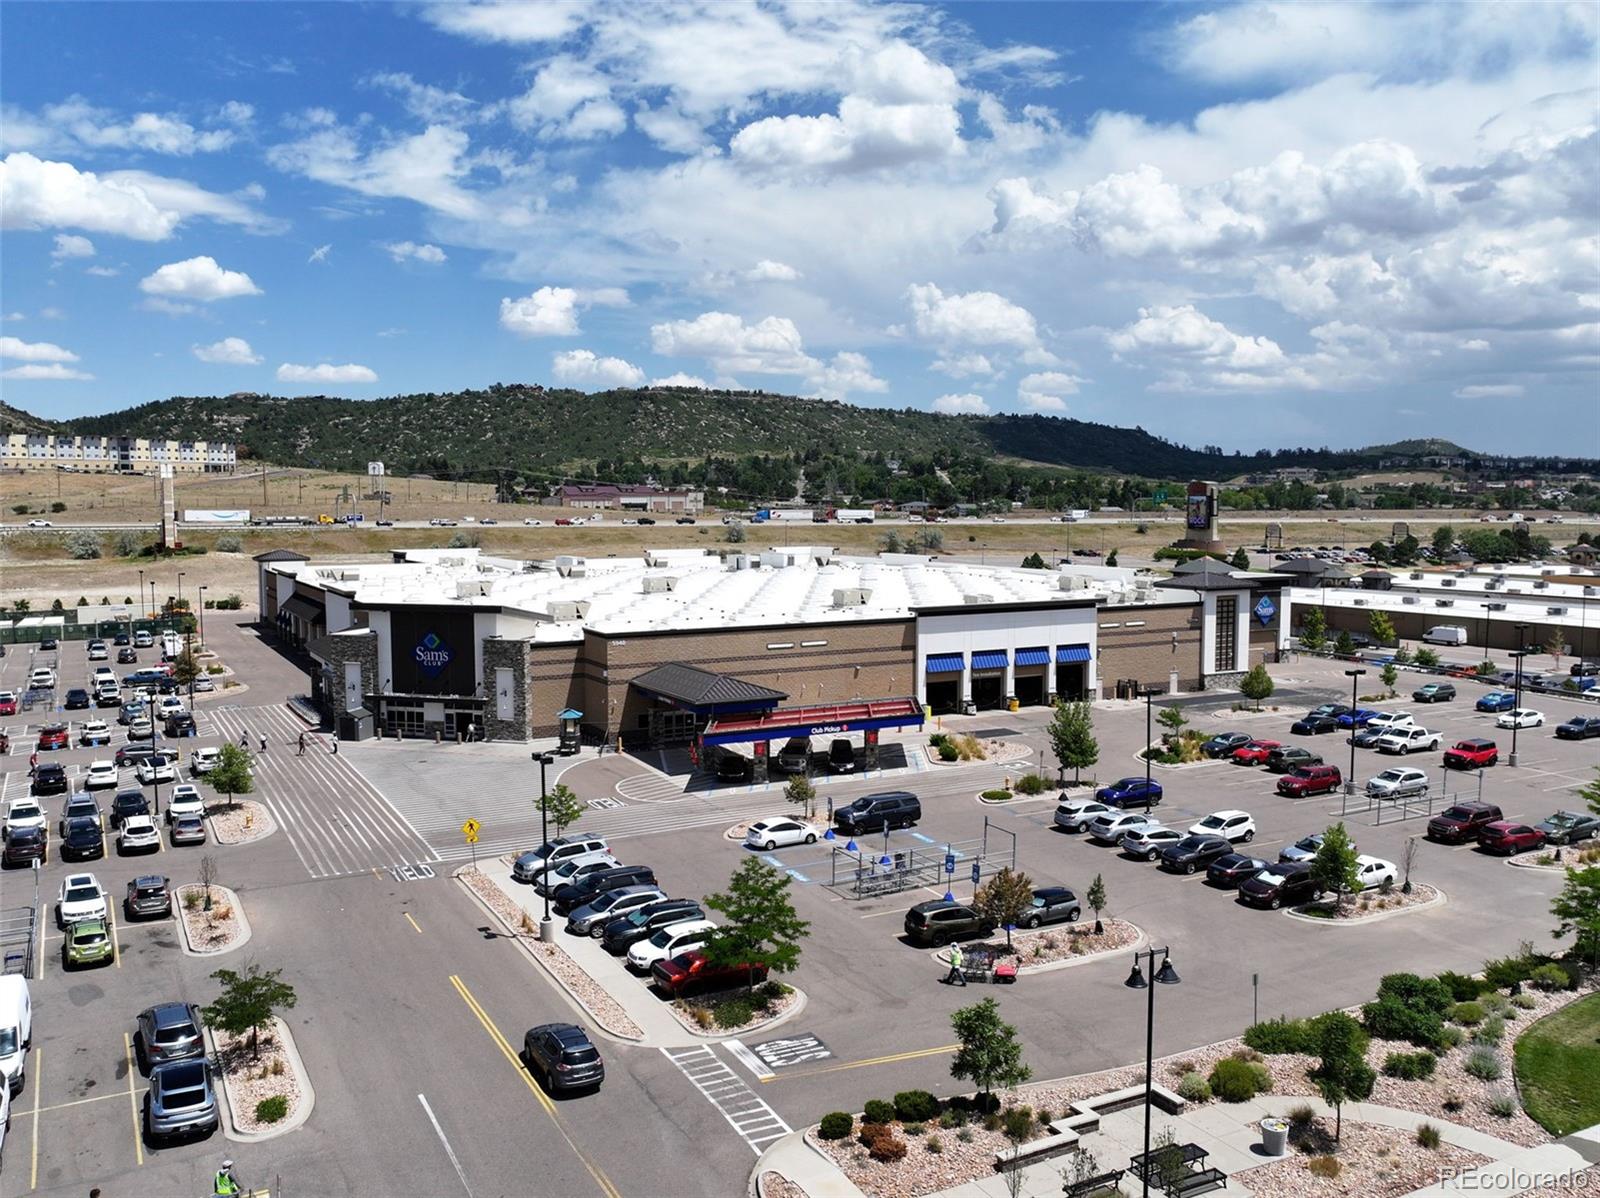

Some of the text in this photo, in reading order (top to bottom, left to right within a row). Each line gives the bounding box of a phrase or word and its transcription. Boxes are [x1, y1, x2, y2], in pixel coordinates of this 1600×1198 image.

[416, 646, 449, 662] Sam's
[824, 725, 841, 733] Pickup
[388, 864, 435, 882] YIELD
